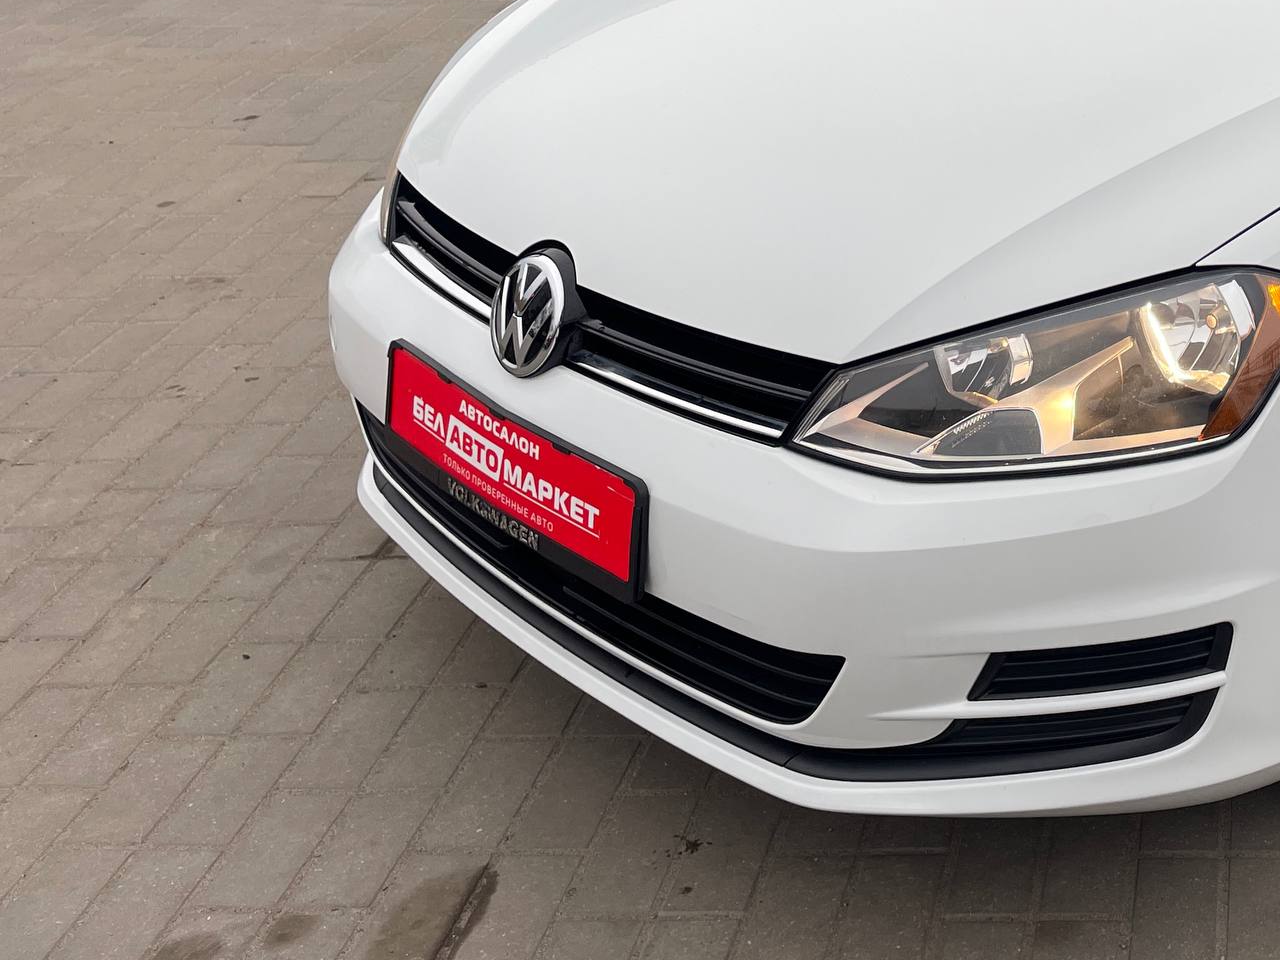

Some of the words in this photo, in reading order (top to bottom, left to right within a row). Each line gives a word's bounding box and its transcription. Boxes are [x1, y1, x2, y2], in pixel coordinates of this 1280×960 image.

[459, 399, 540, 460] АВТОСАЛОН
[443, 453, 471, 481] ТОЛЬКО
[472, 474, 529, 518] ПРОВЕРЕННЫЕ
[530, 512, 554, 532] АВТО
